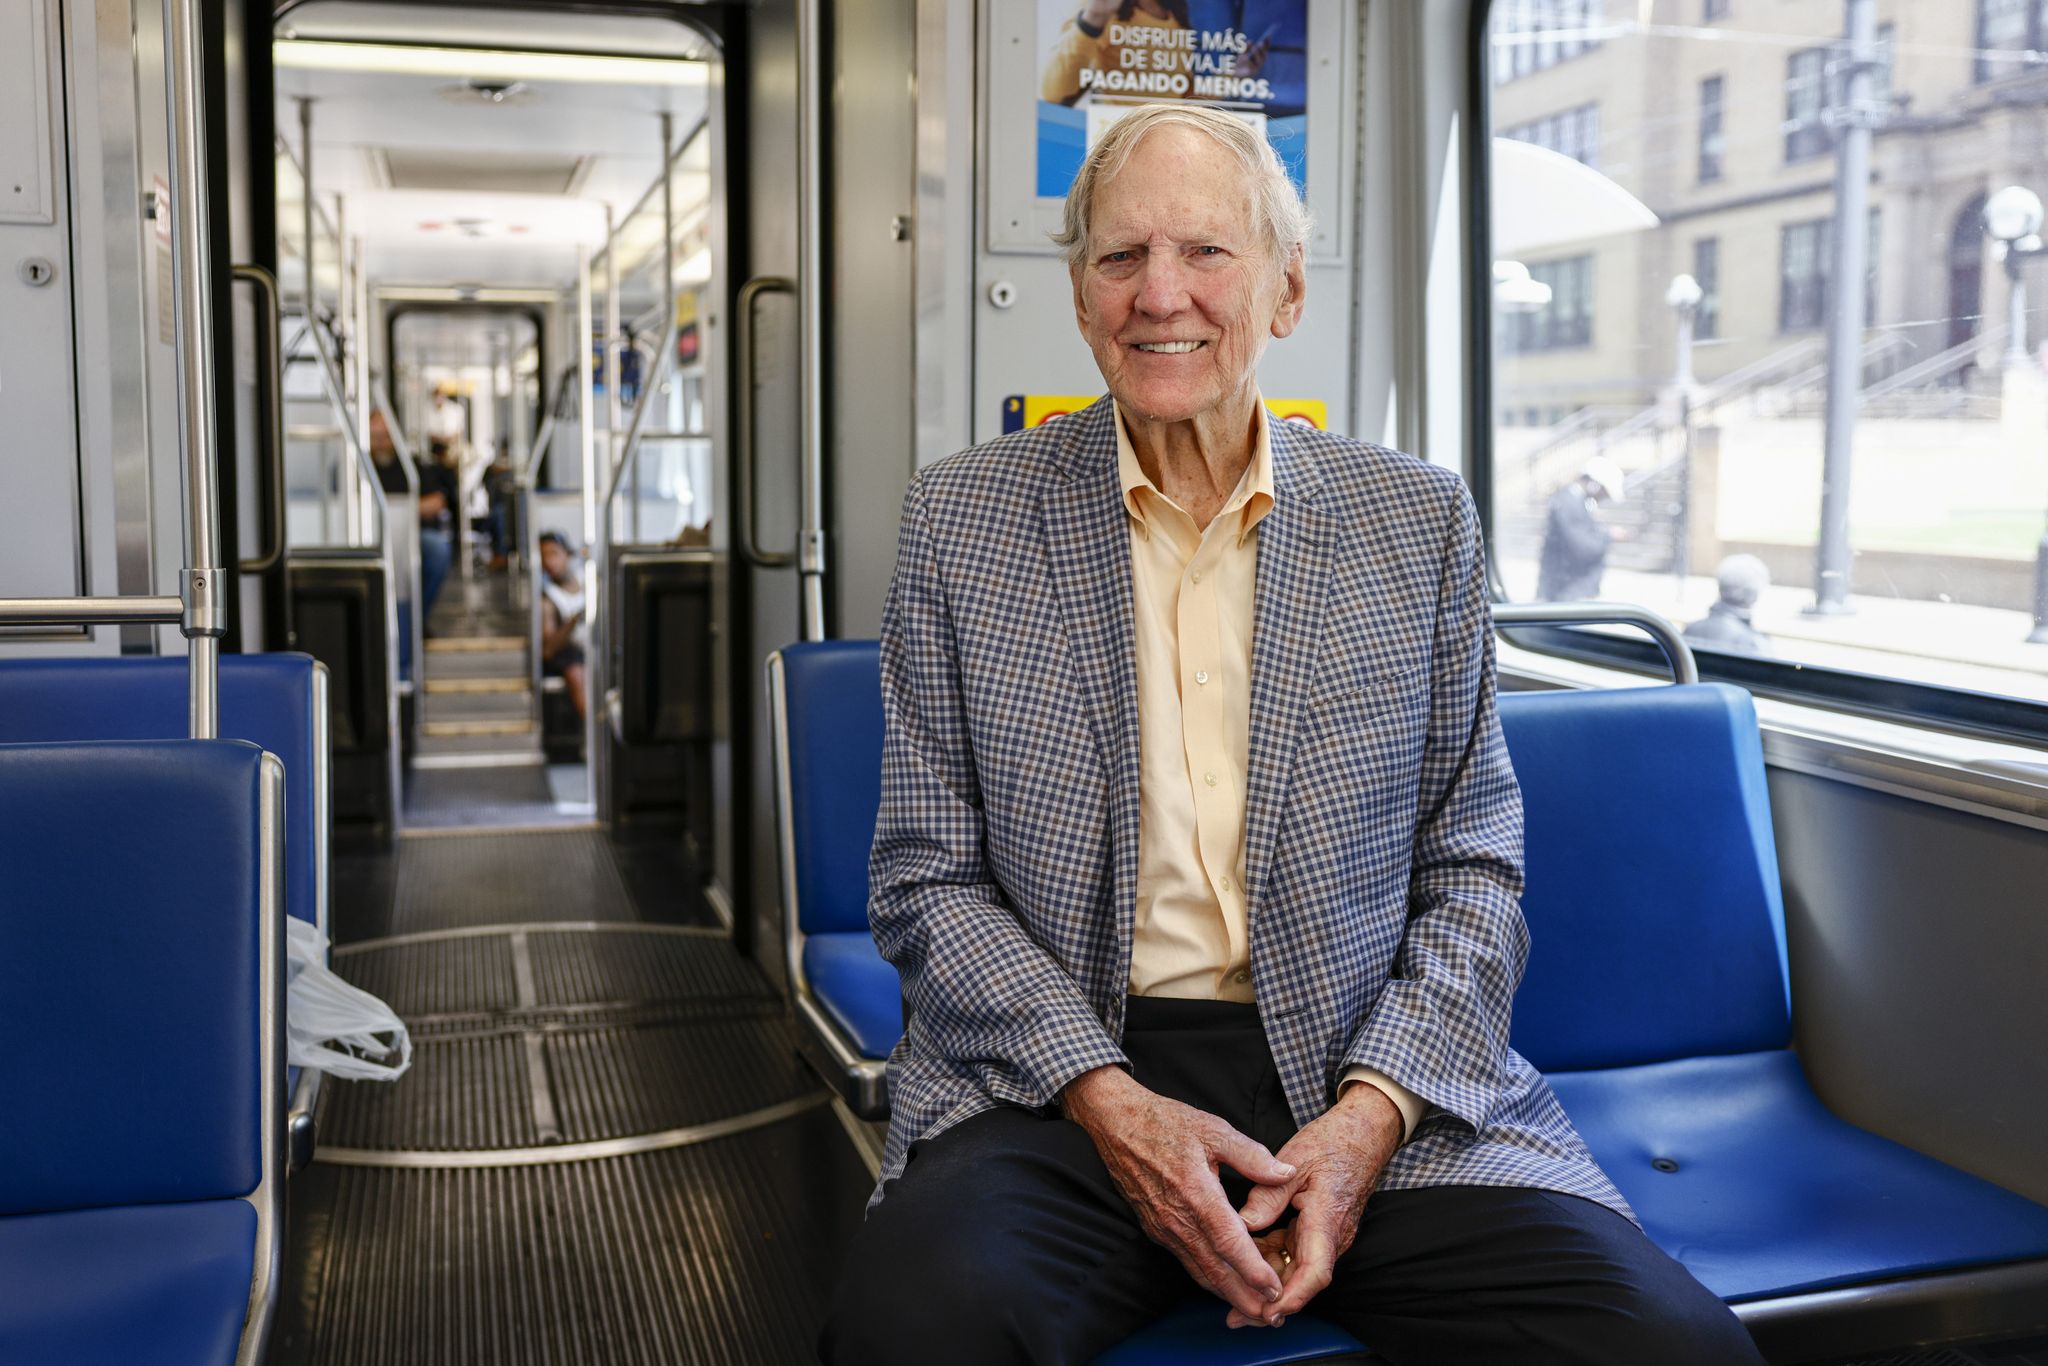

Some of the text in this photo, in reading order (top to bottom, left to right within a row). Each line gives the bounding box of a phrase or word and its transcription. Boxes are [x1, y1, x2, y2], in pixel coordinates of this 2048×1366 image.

[1110, 25, 1248, 53] DISFRUTE MÁS
[1120, 48, 1236, 73] DE SU VIAJE
[1079, 68, 1275, 99] PAGANDO MENOS.
